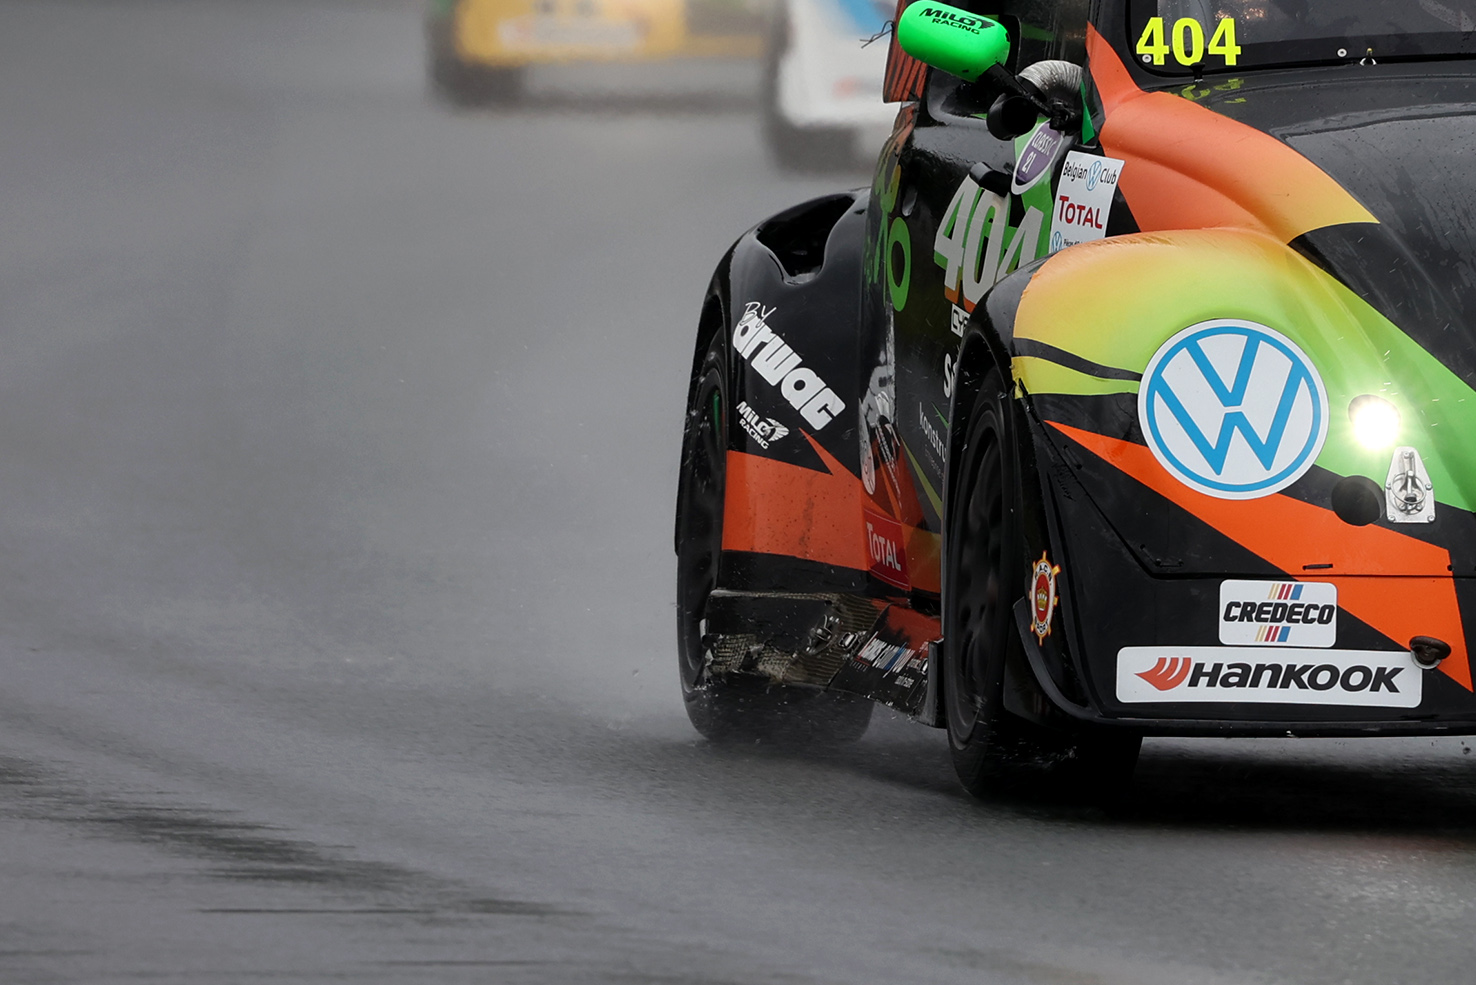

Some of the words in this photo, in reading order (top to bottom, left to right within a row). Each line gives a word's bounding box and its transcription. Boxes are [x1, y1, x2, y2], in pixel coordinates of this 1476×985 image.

[931, 18, 980, 35] RACING
[1136, 17, 1241, 66] 404
[1021, 151, 1037, 174] 21
[1062, 161, 1088, 182] Belgian
[1100, 168, 1117, 185] Club
[739, 418, 770, 450] RACING
[1223, 601, 1335, 625] CREDECO
